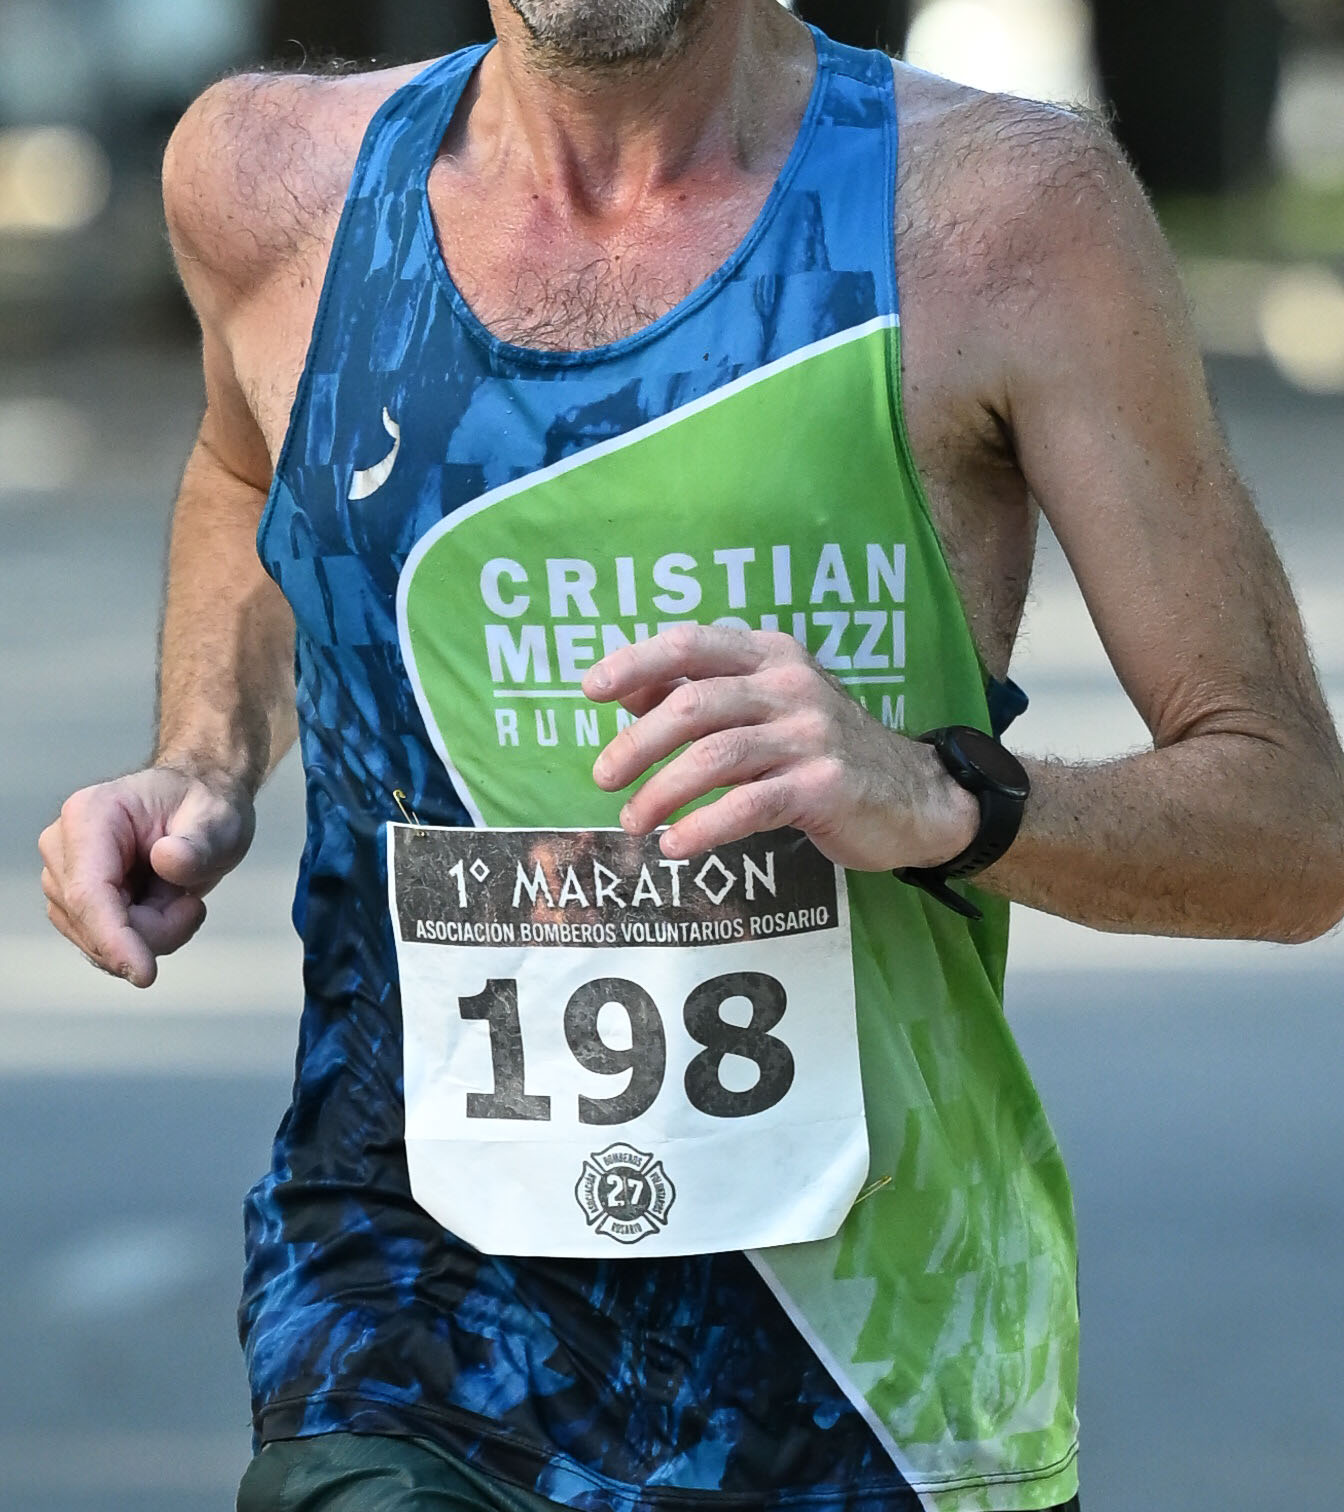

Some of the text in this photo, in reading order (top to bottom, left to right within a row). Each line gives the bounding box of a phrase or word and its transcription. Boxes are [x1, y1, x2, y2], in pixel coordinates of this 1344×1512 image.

[480, 544, 905, 618] CRISTIAN
[416, 906, 830, 943] ASOCIACIÓN BOMBEROS VOLUNTARIOS ROSARIO
[458, 971, 795, 1126] 198
[606, 1174, 644, 1208] 27
